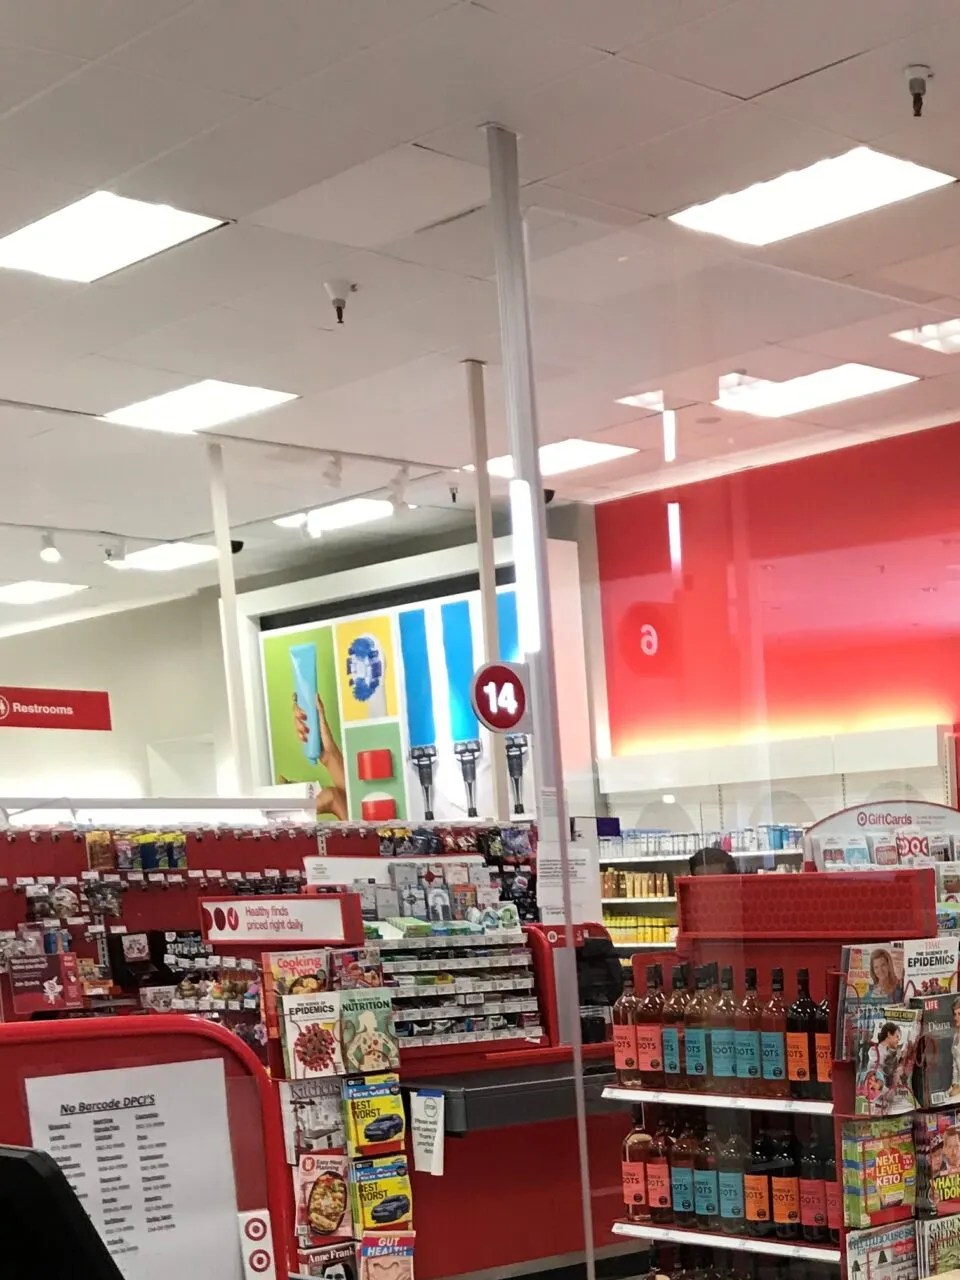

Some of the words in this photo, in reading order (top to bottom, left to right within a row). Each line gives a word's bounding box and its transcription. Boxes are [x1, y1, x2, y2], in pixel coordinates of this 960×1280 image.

[482, 681, 519, 715] 14
[12, 701, 74, 715] Restrooms
[867, 812, 913, 826] GiftCards
[245, 905, 270, 918] Healthy
[270, 905, 289, 916] finds
[246, 919, 269, 931] priced
[269, 919, 286, 932] right
[286, 918, 304, 932] daily
[277, 956, 322, 969] Cooking
[907, 954, 955, 968] EPIDEMICS
[288, 1004, 335, 1016] EPIDEMICS
[342, 999, 390, 1012] NUTRITION
[924, 999, 938, 1011] LIFE
[928, 1020, 951, 1033] Diana
[60, 1103, 77, 1115] No
[78, 1099, 121, 1112] Barcode
[352, 1100, 371, 1111] BEST
[354, 1107, 382, 1120] WORST
[875, 1153, 900, 1166] NEXT
[876, 1163, 904, 1177] LEVEL
[876, 1173, 900, 1187] KETO
[930, 1175, 956, 1192] WHAT
[358, 1181, 378, 1193] BEST
[359, 1190, 388, 1202] WORST
[378, 1236, 401, 1247] GUT
[308, 1252, 330, 1264] Anne
[330, 1247, 355, 1260] Frank
